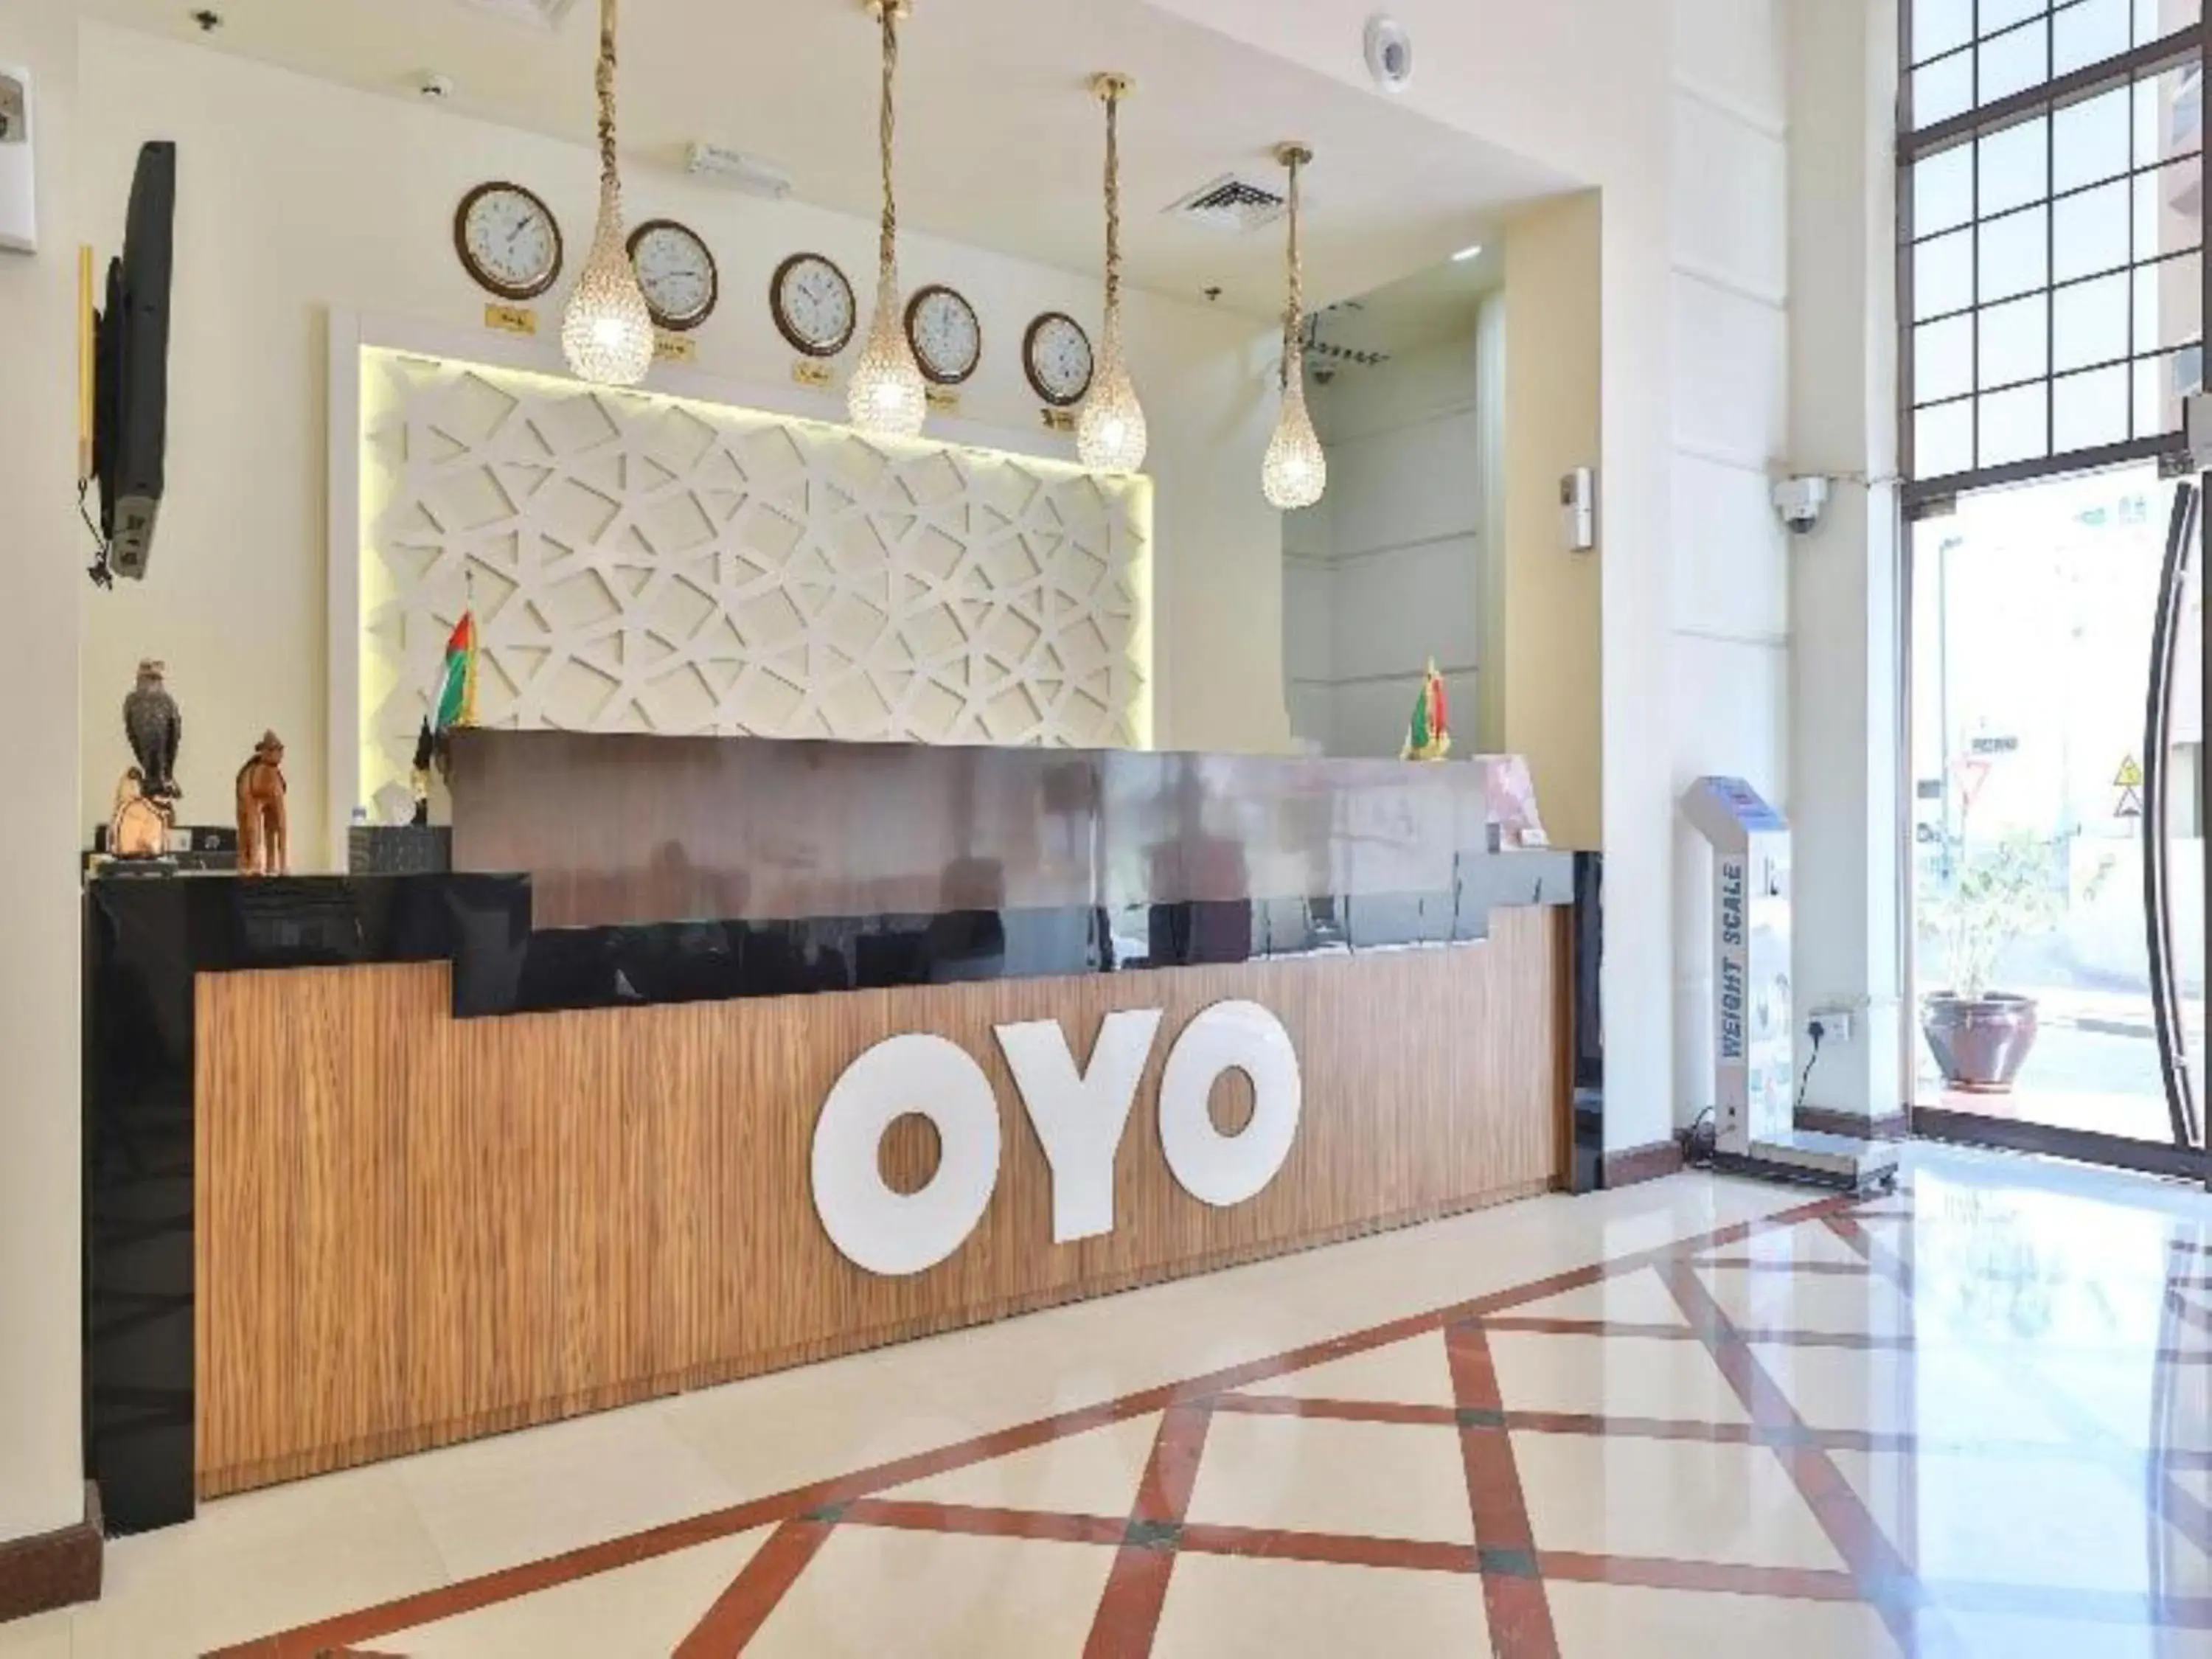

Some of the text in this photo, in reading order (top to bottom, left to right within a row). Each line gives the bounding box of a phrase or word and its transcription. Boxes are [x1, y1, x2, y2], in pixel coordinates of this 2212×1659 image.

[1722, 861, 1742, 1057] WEIGHT SCALE
[811, 999, 1301, 1276] OYO
